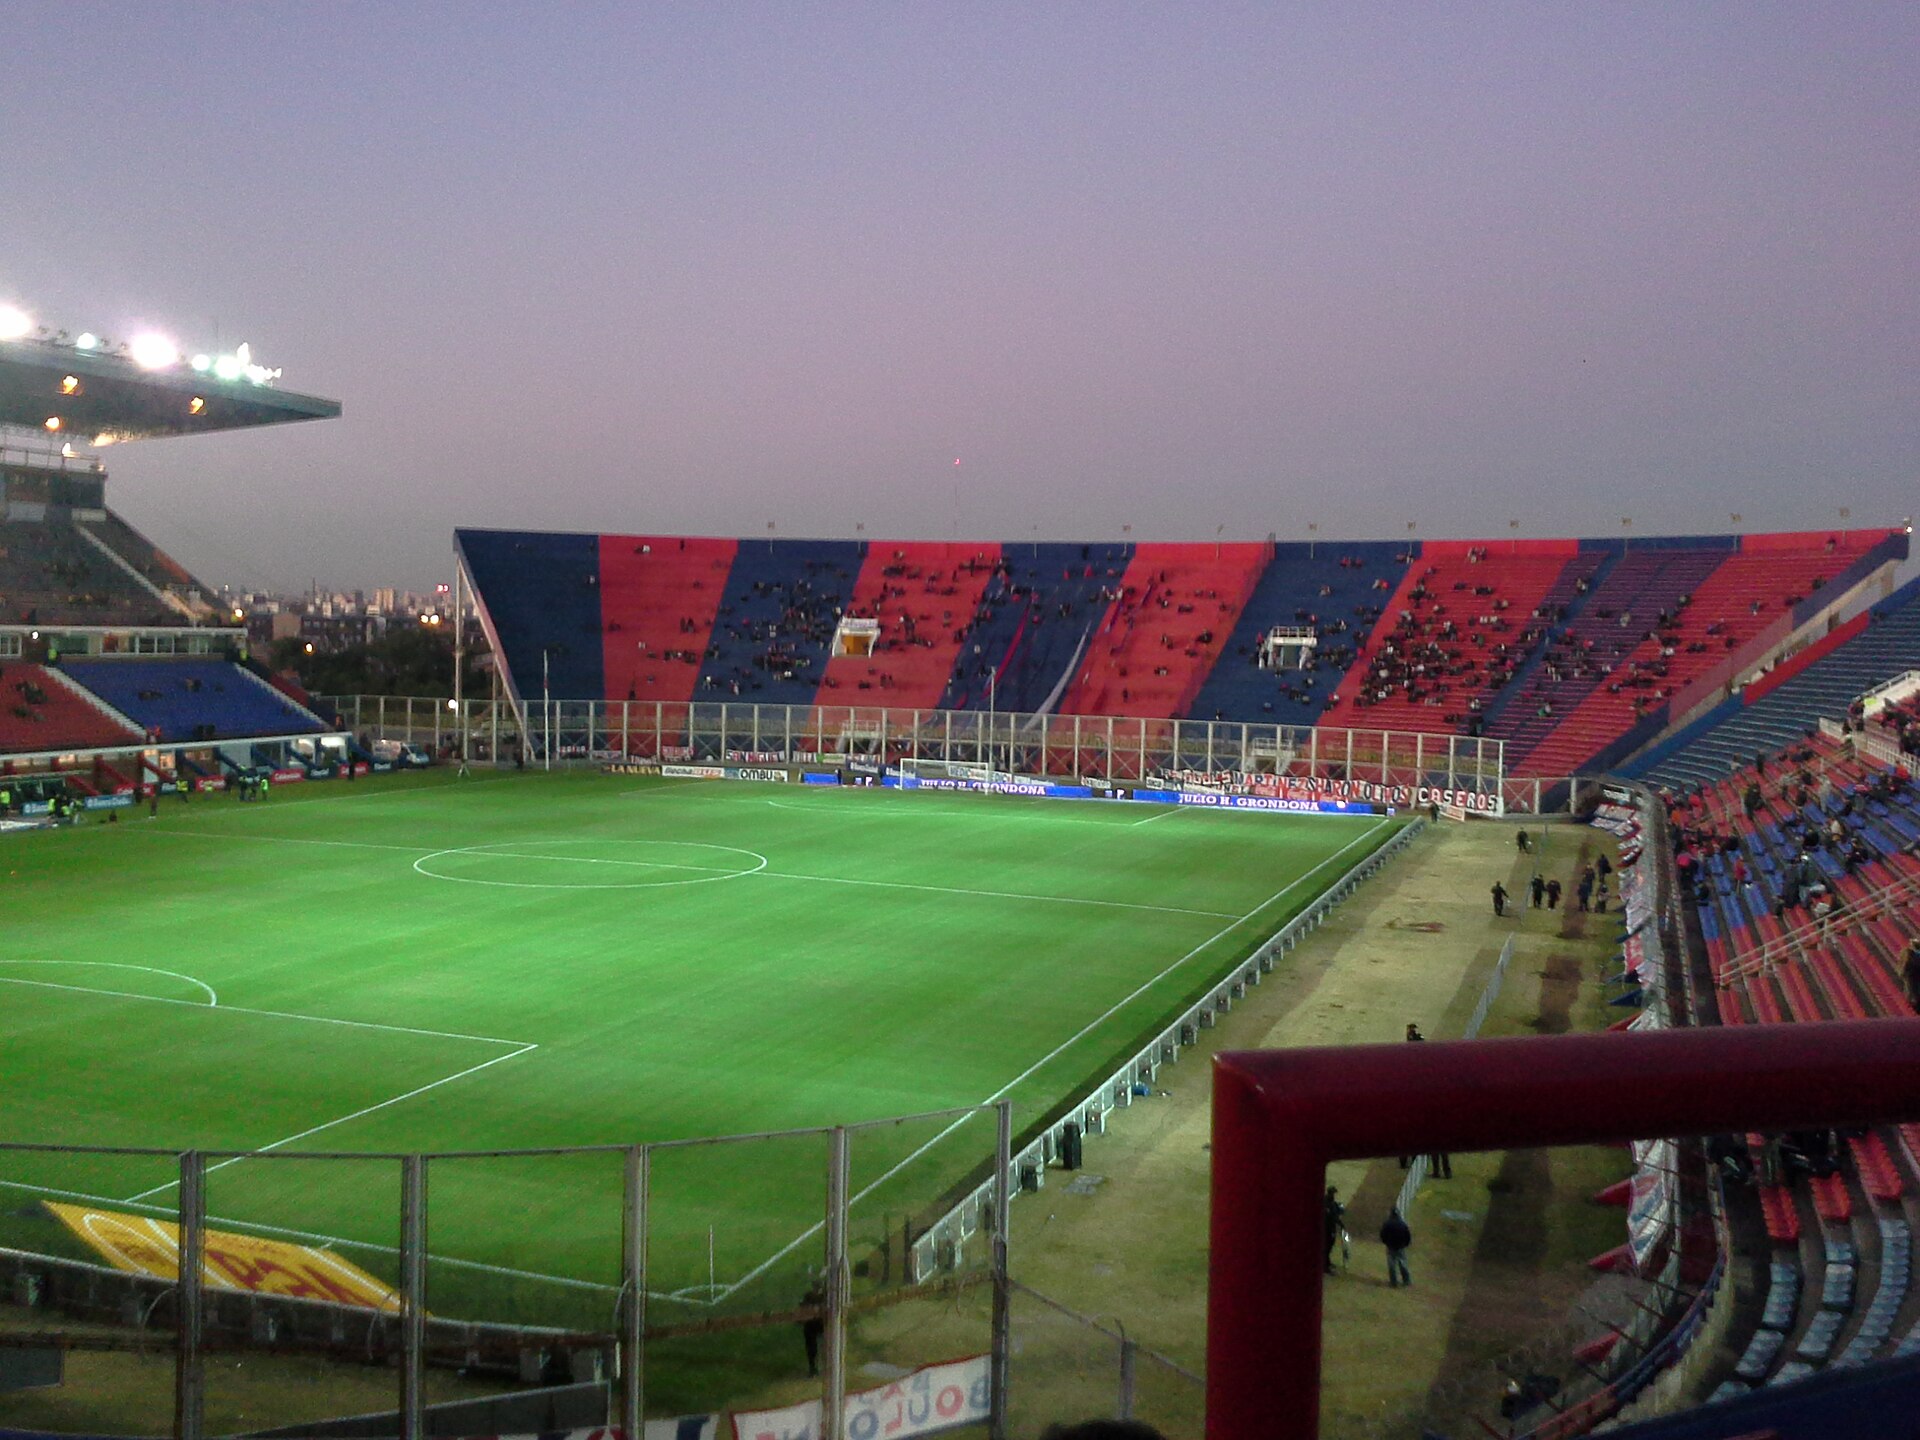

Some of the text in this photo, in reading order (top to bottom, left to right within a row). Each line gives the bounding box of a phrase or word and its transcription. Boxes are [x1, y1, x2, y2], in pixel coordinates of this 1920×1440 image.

[1179, 793, 1320, 811] JULIO H. GRONDONA
[1418, 787, 1497, 812] CASEROS
